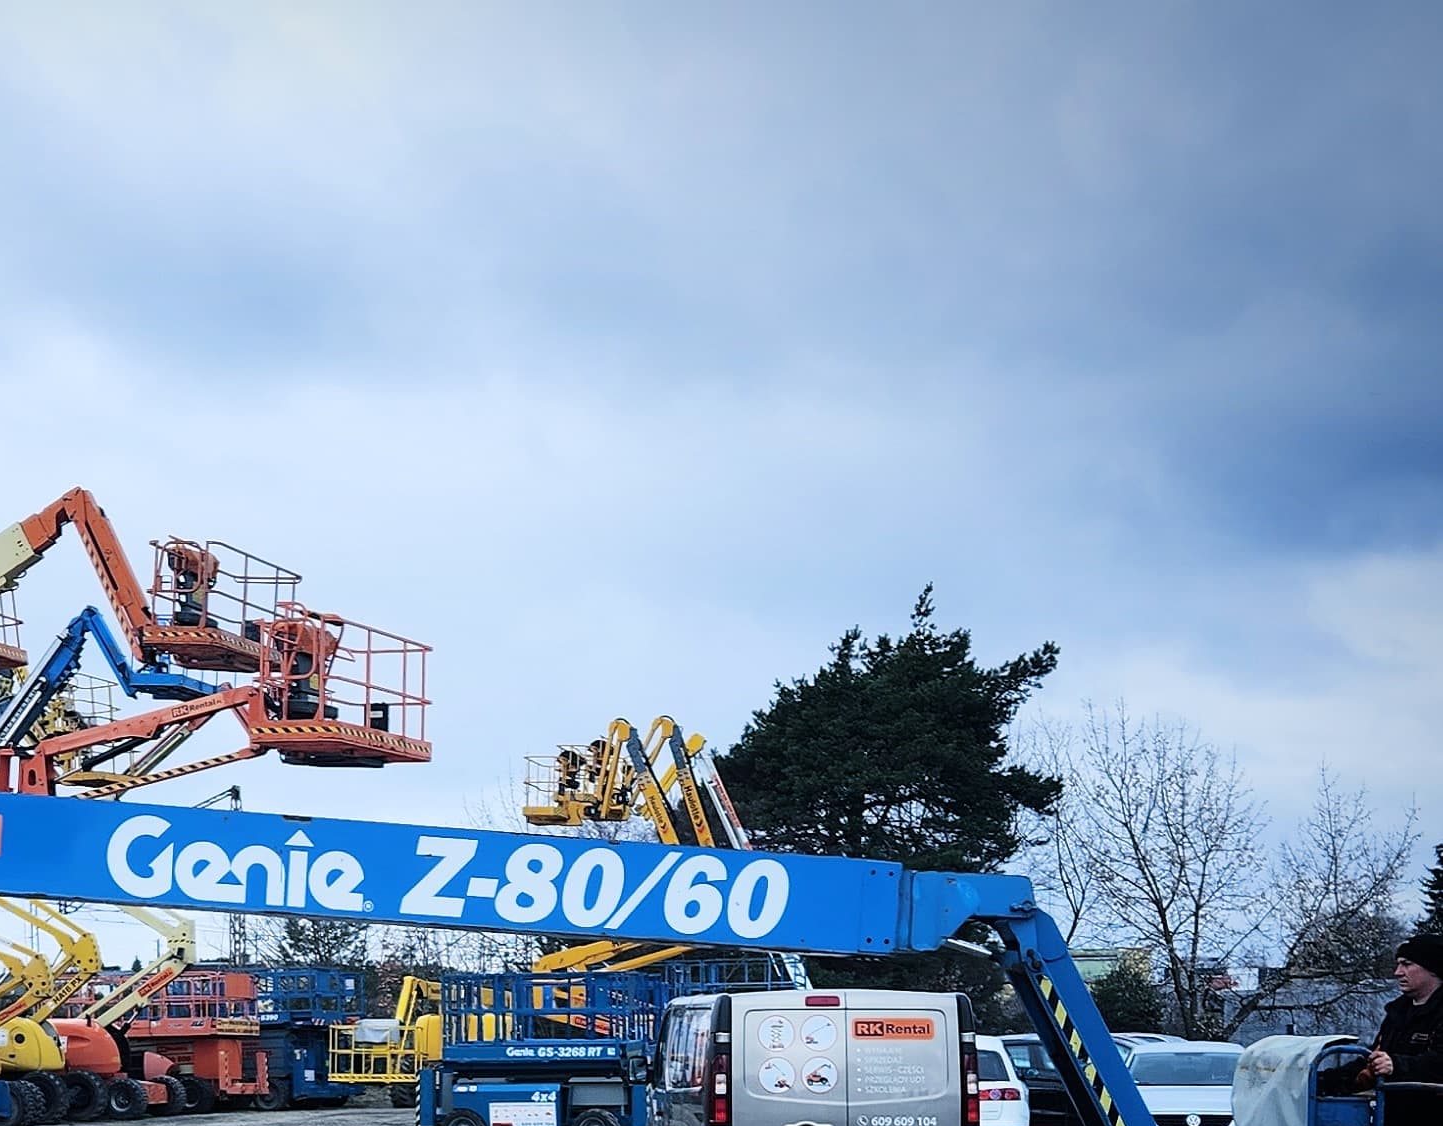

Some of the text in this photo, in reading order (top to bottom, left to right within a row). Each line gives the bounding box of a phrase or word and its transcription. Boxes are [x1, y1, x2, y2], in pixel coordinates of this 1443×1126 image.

[105, 814, 790, 940] Genie Z-80/60
[885, 1023, 930, 1034] Rental
[537, 1047, 586, 1057] GS-3268
[587, 1047, 603, 1056] RT
[531, 1091, 557, 1102] 4x4
[871, 1116, 938, 1126] 609 609 104
